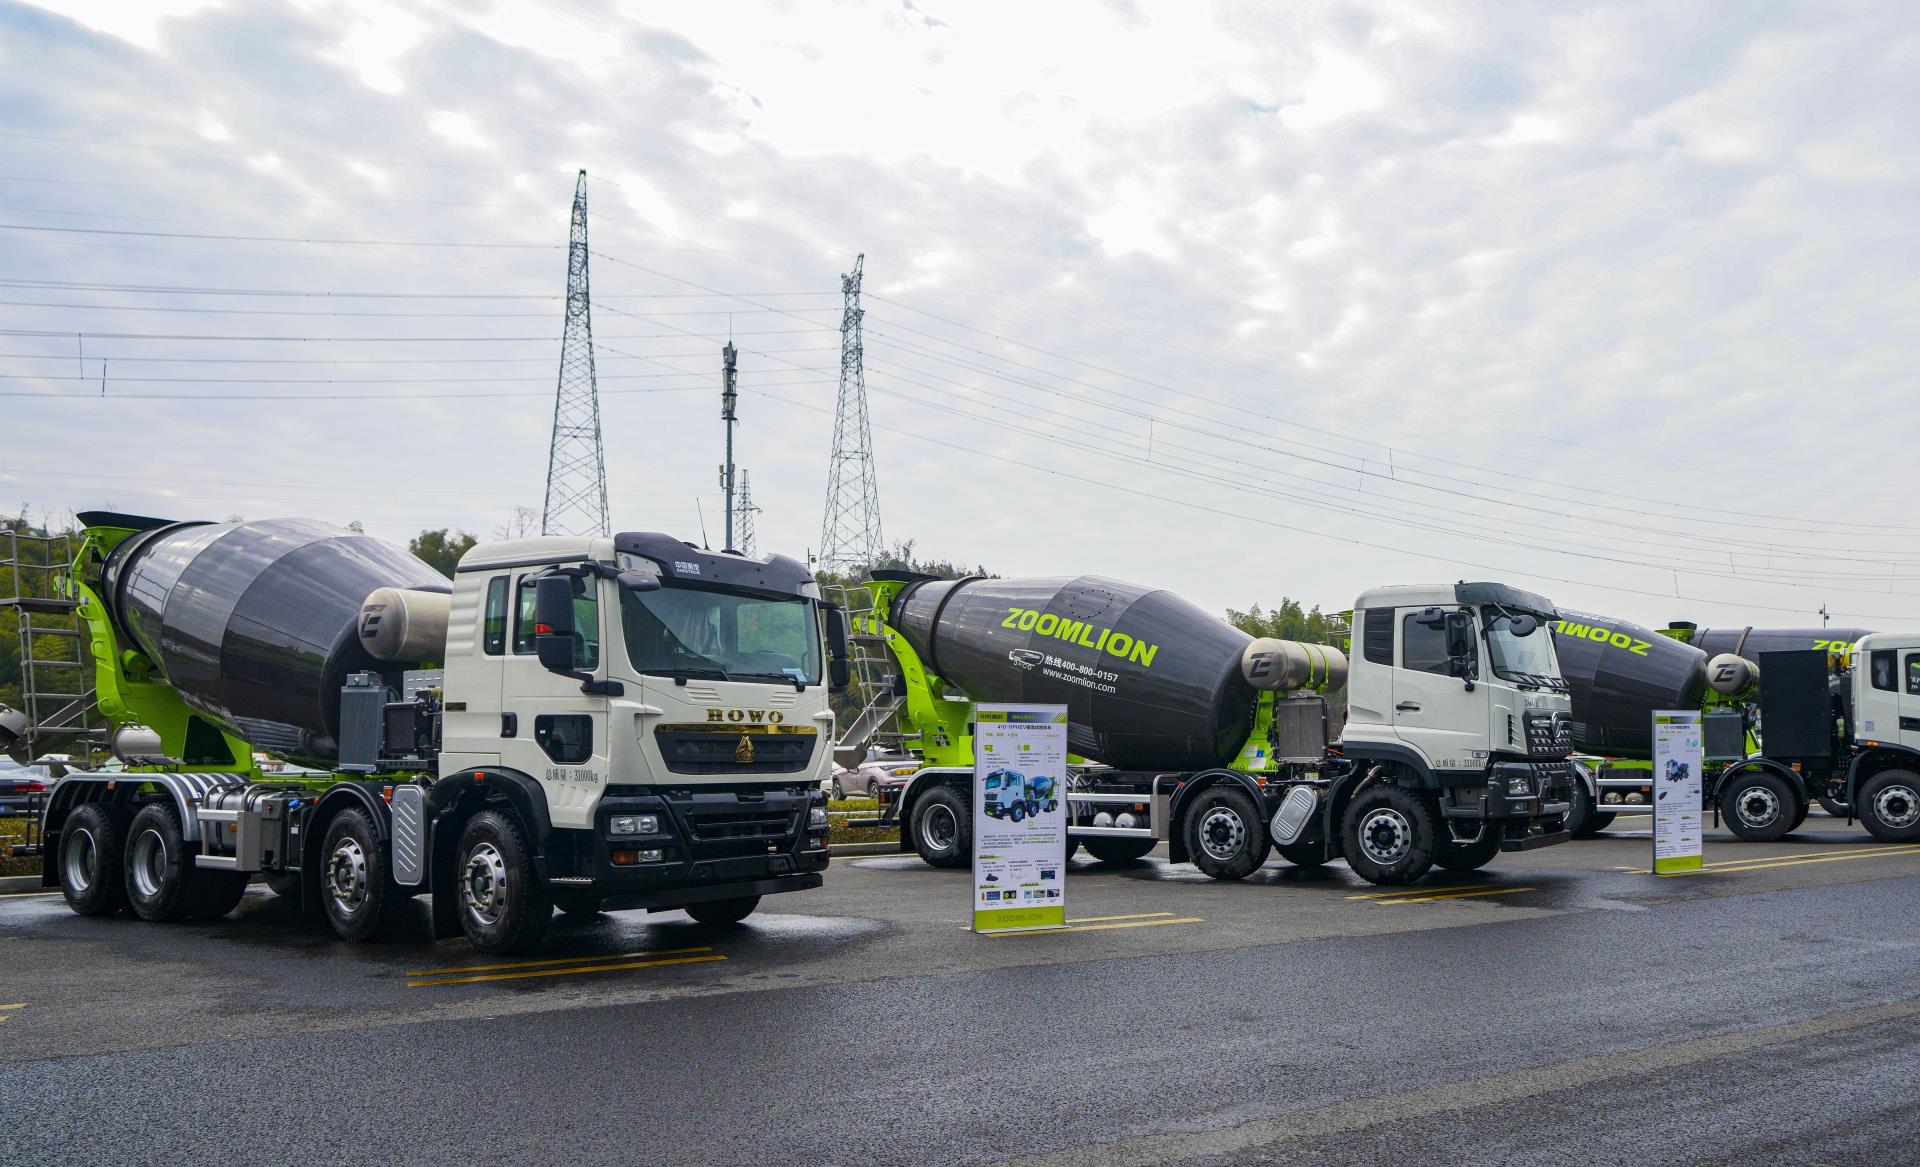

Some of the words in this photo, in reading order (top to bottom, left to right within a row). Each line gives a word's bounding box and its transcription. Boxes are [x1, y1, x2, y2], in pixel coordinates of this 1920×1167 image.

[1001, 607, 1158, 667] ZOOMLION
[1042, 667, 1116, 694] www.zoomlion.com
[706, 708, 784, 723] HOWO
